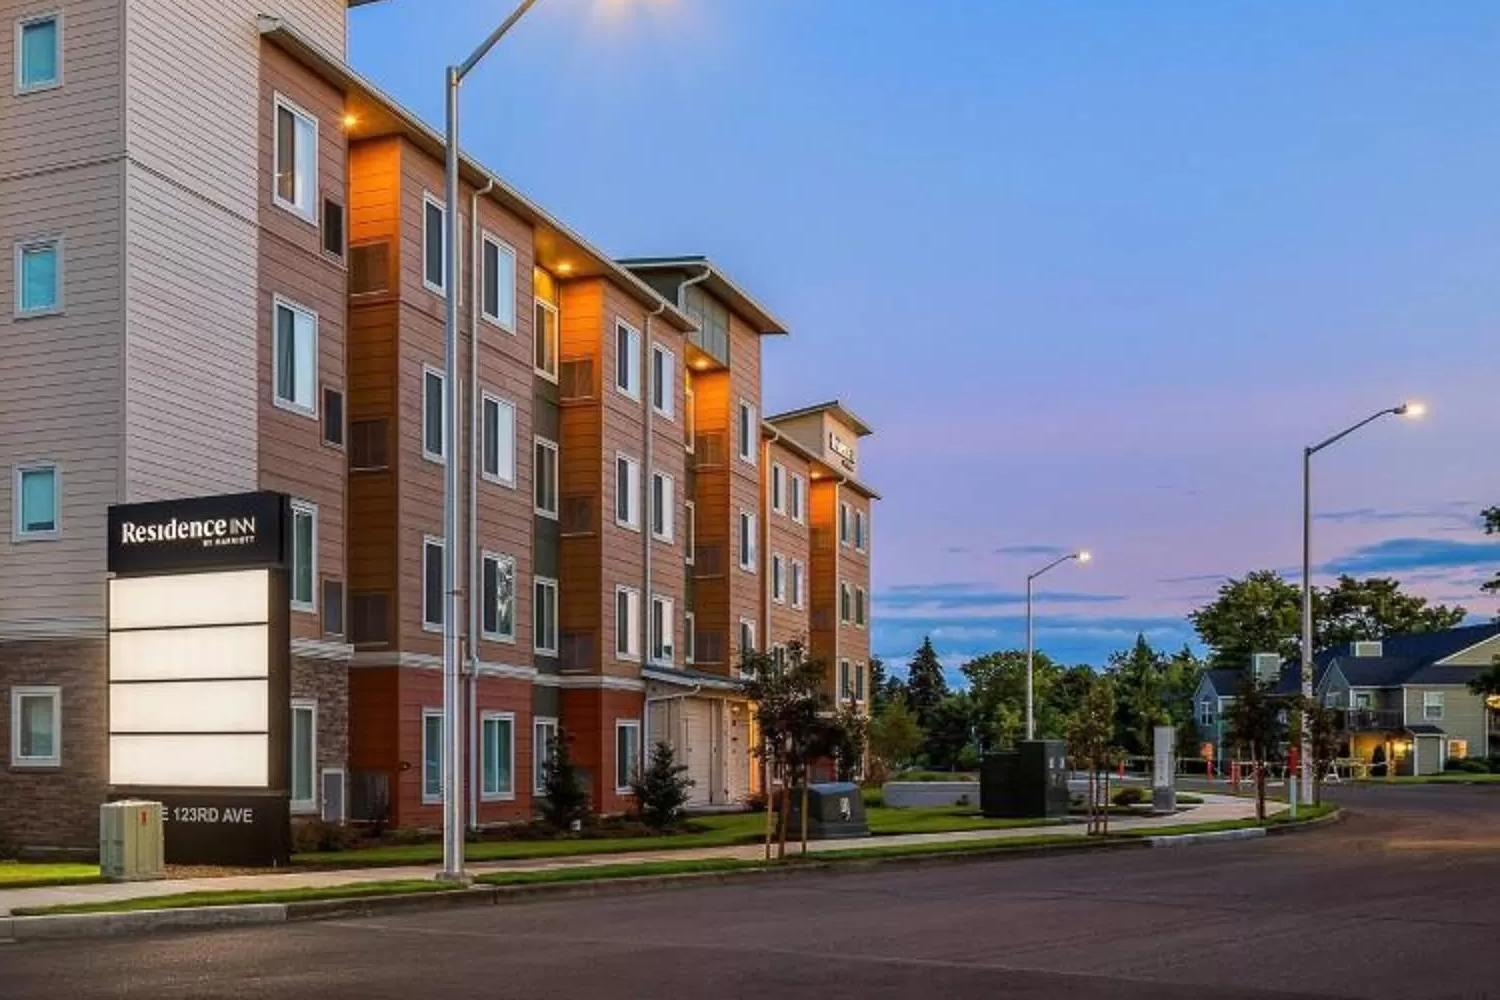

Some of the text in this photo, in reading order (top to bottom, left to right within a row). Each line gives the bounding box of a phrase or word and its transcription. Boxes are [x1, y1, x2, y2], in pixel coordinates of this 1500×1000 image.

[121, 515, 256, 544] Residence INN
[173, 807, 219, 823] 123RD
[221, 807, 253, 823] AVE
